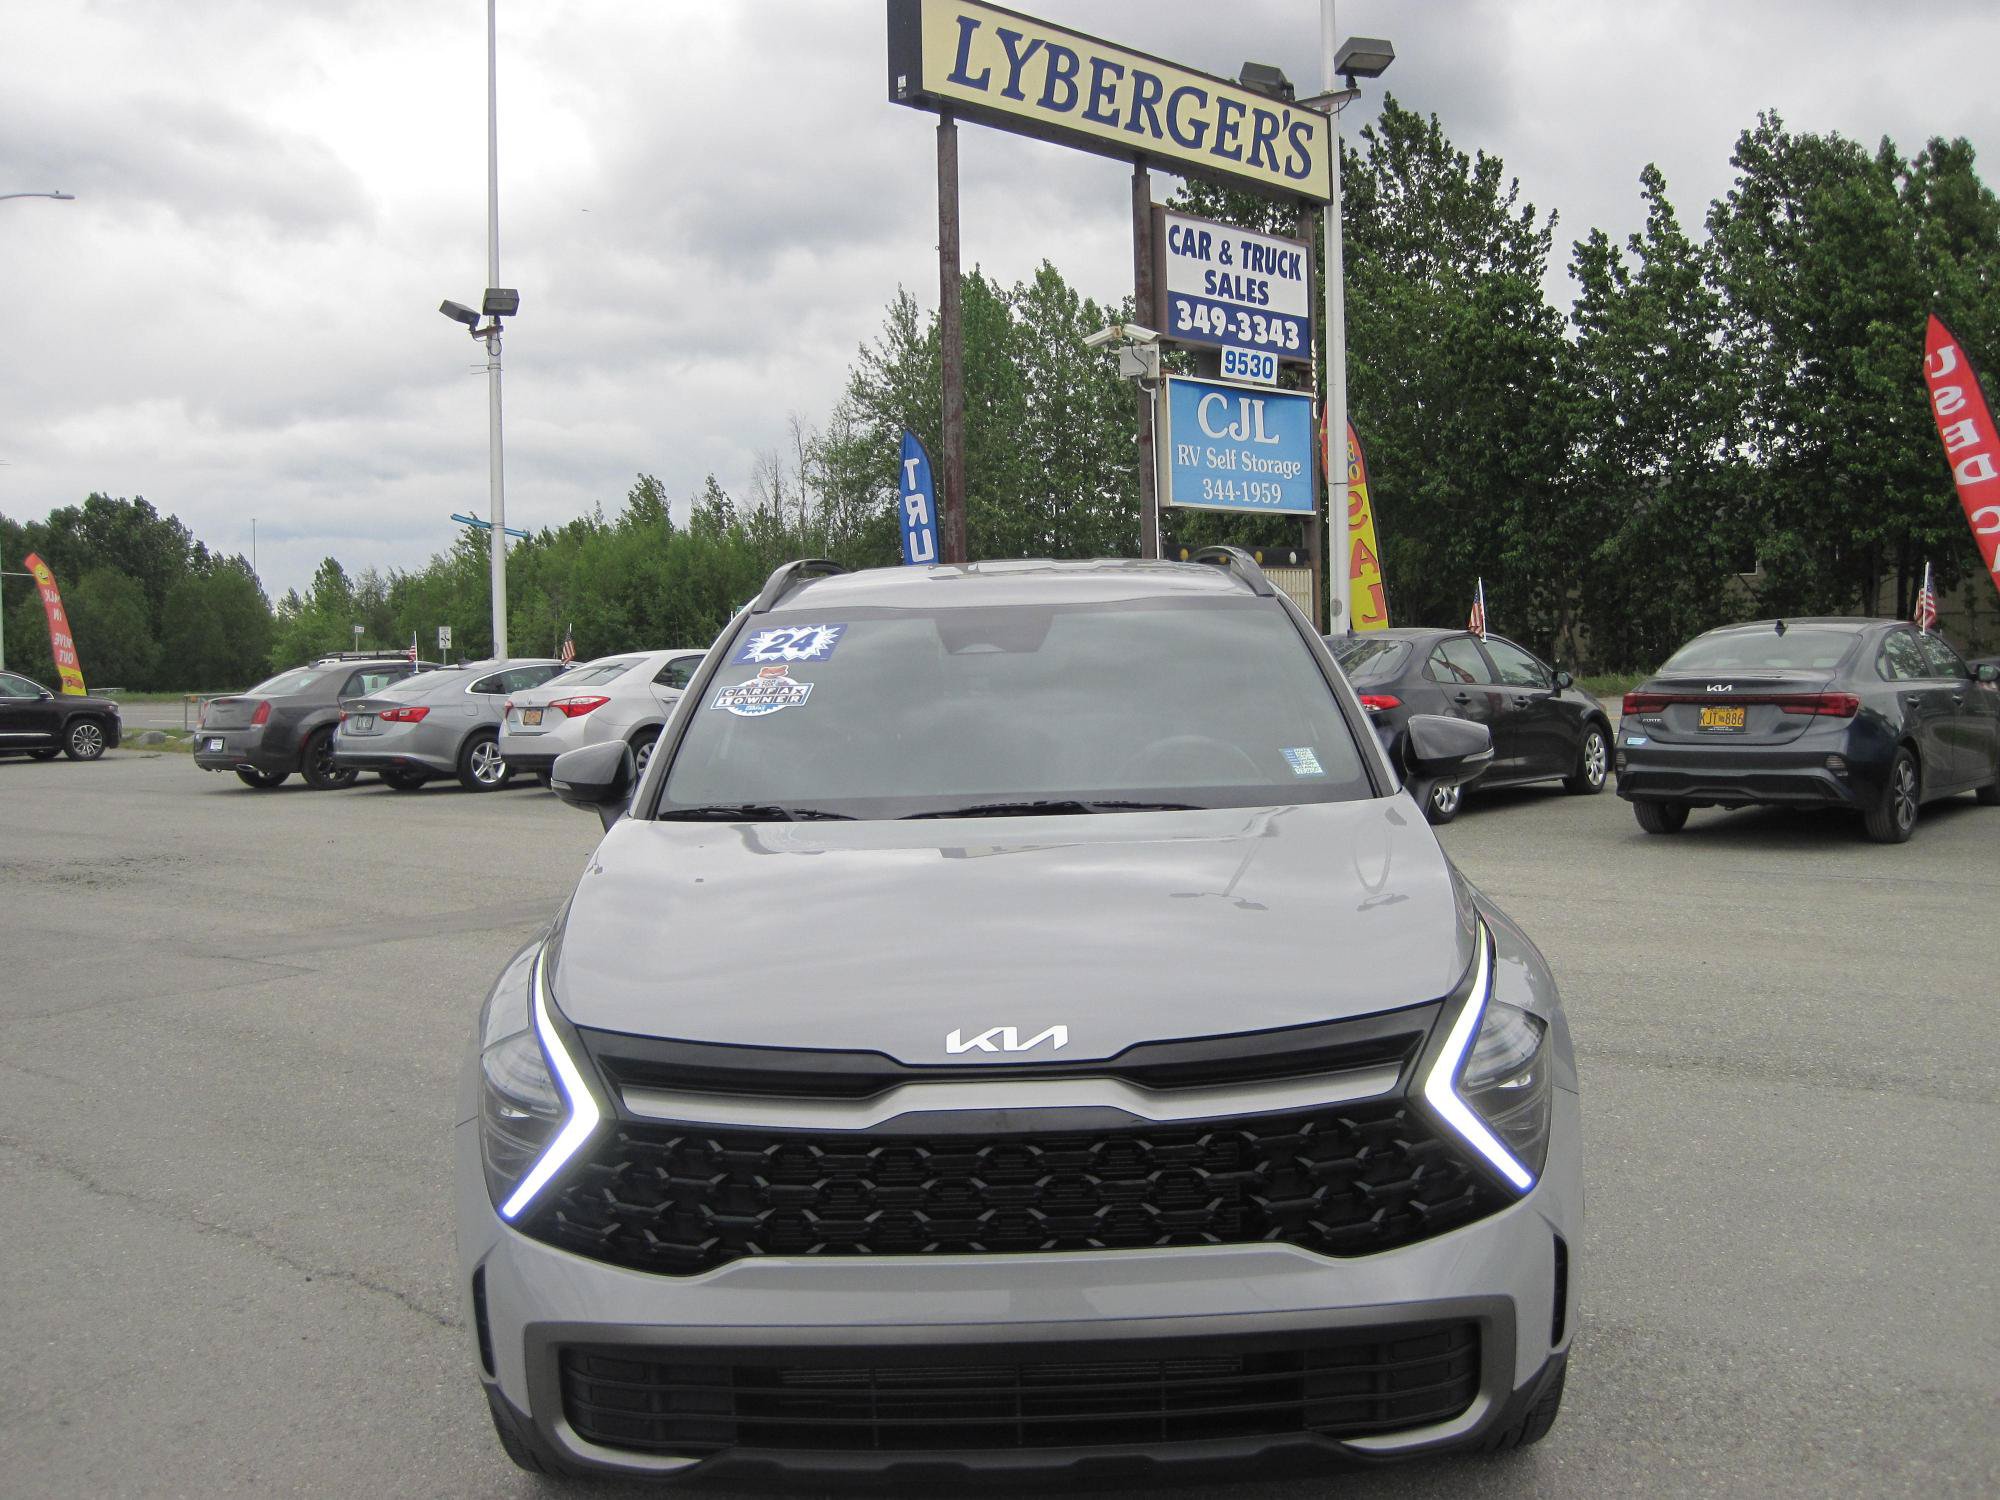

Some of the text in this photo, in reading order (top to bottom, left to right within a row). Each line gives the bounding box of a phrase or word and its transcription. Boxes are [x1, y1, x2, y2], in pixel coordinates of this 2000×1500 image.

[946, 14, 1314, 181] LYBERGER'S
[1168, 224, 1302, 281] CAR & TRUCK
[1204, 269, 1270, 306] SALES
[1175, 299, 1300, 350] 349-3343
[1224, 350, 1274, 380] 9530
[1197, 392, 1280, 444] CJL
[1177, 443, 1302, 480] RV Self Storage
[1202, 477, 1283, 504] 344-1959
[760, 630, 821, 654] 24
[724, 686, 806, 697] CARFAX
[733, 694, 801, 705] OWNER
[1706, 684, 1734, 692] KIA
[1725, 712, 1744, 725] 886
[946, 1024, 1069, 1054] KIA
